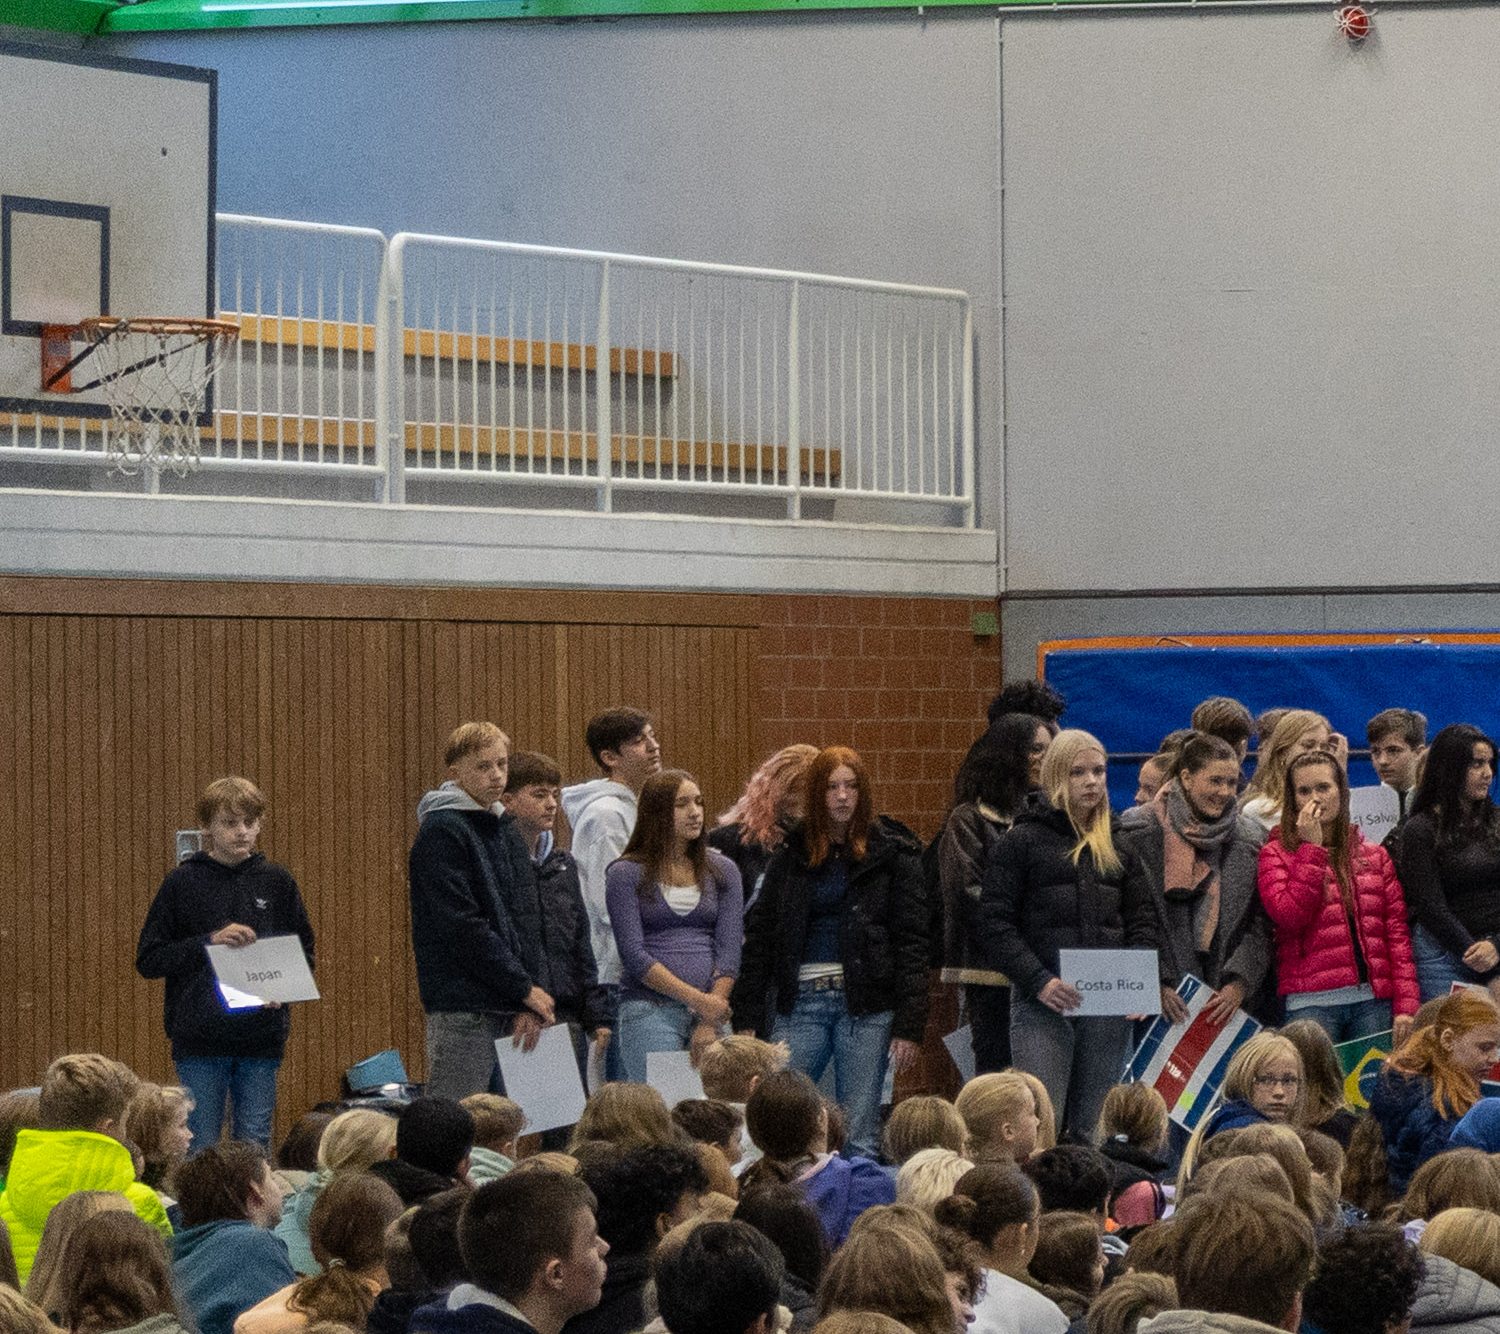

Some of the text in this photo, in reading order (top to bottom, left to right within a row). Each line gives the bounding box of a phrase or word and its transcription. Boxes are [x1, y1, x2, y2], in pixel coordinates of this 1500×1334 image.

[245, 970, 283, 983] Japan
[1075, 978, 1145, 992] Costa Rica
